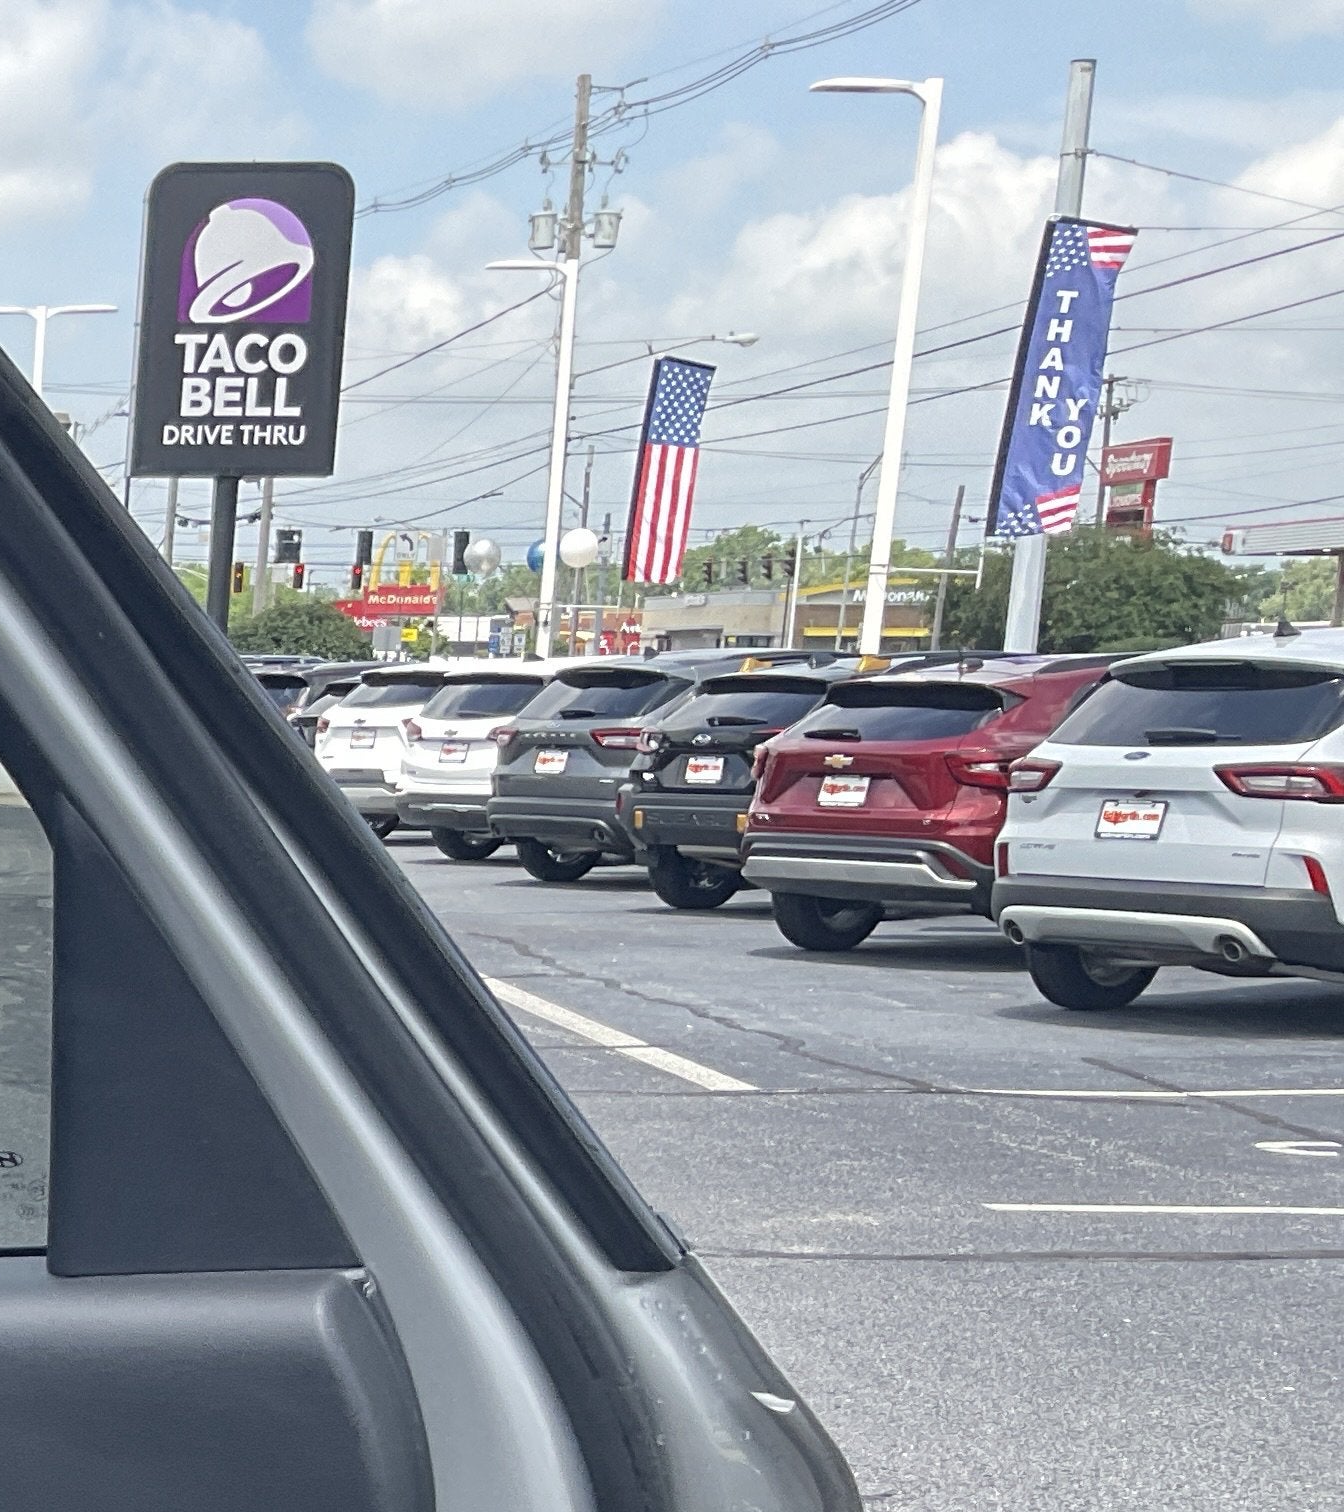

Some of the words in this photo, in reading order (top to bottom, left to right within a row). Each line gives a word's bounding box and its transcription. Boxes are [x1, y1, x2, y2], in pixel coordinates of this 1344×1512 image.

[174, 333, 307, 374] TACO
[1029, 290, 1079, 427] THANK
[180, 377, 301, 418] BELL
[162, 425, 234, 446] DRIVE
[240, 425, 306, 446] THRU
[1050, 397, 1089, 477] YOU
